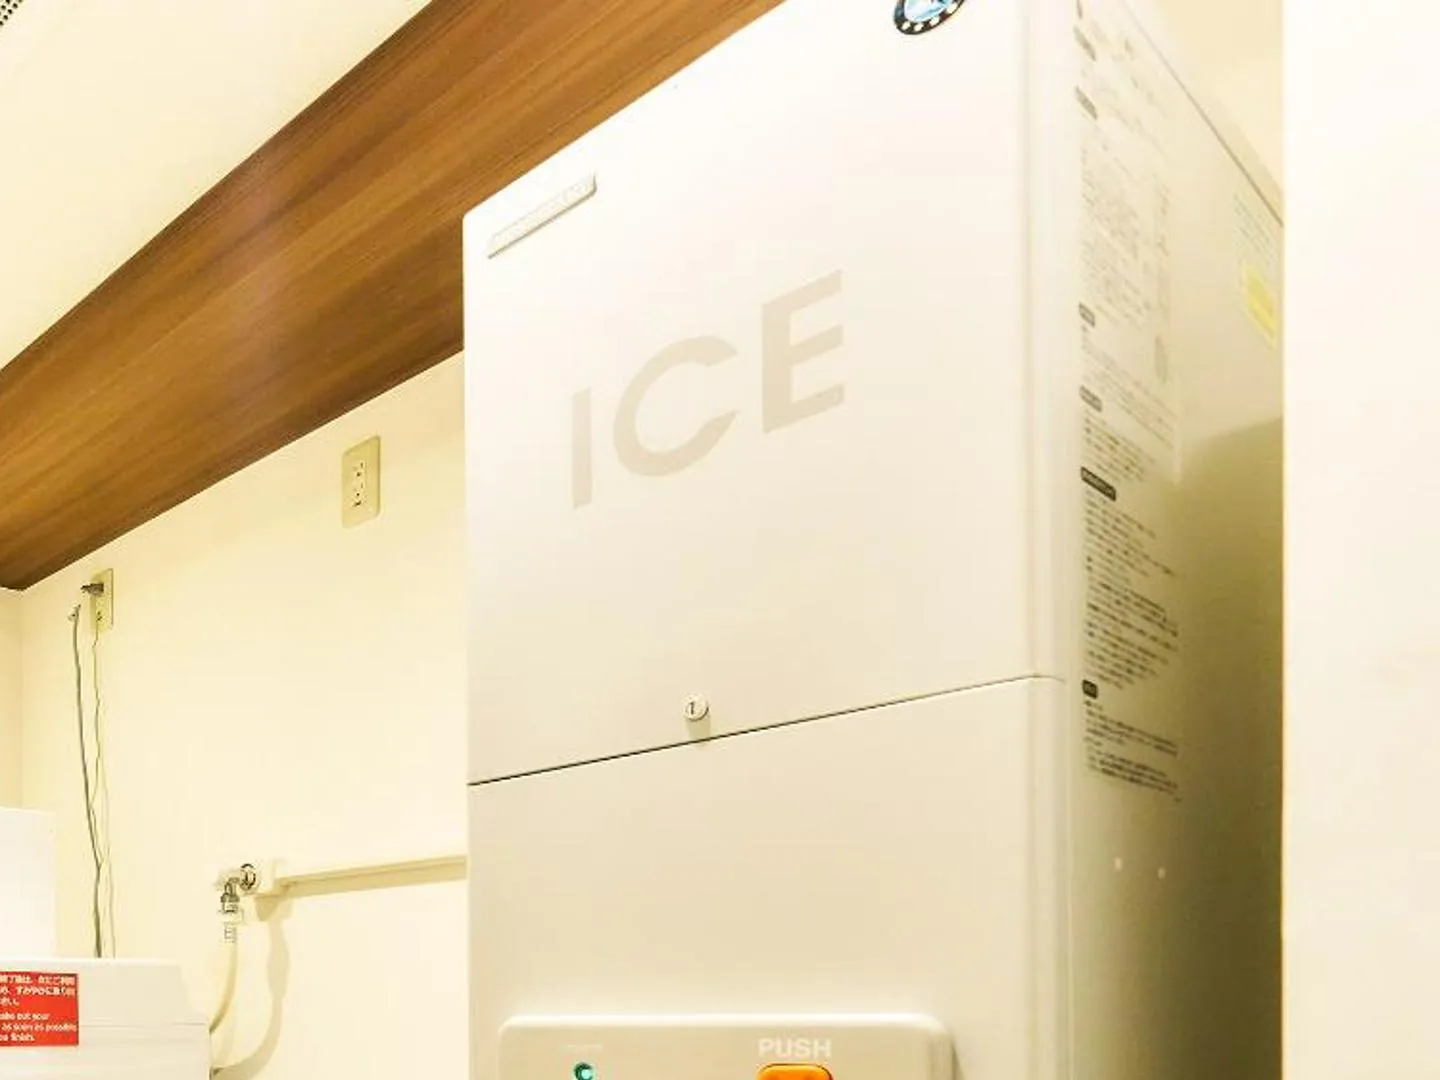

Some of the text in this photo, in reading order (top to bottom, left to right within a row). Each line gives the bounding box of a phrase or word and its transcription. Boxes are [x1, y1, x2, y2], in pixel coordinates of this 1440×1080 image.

[572, 269, 844, 510] ICE
[17, 1012, 32, 1020] out
[32, 1013, 50, 1022] your
[759, 1038, 832, 1059] PUSH
